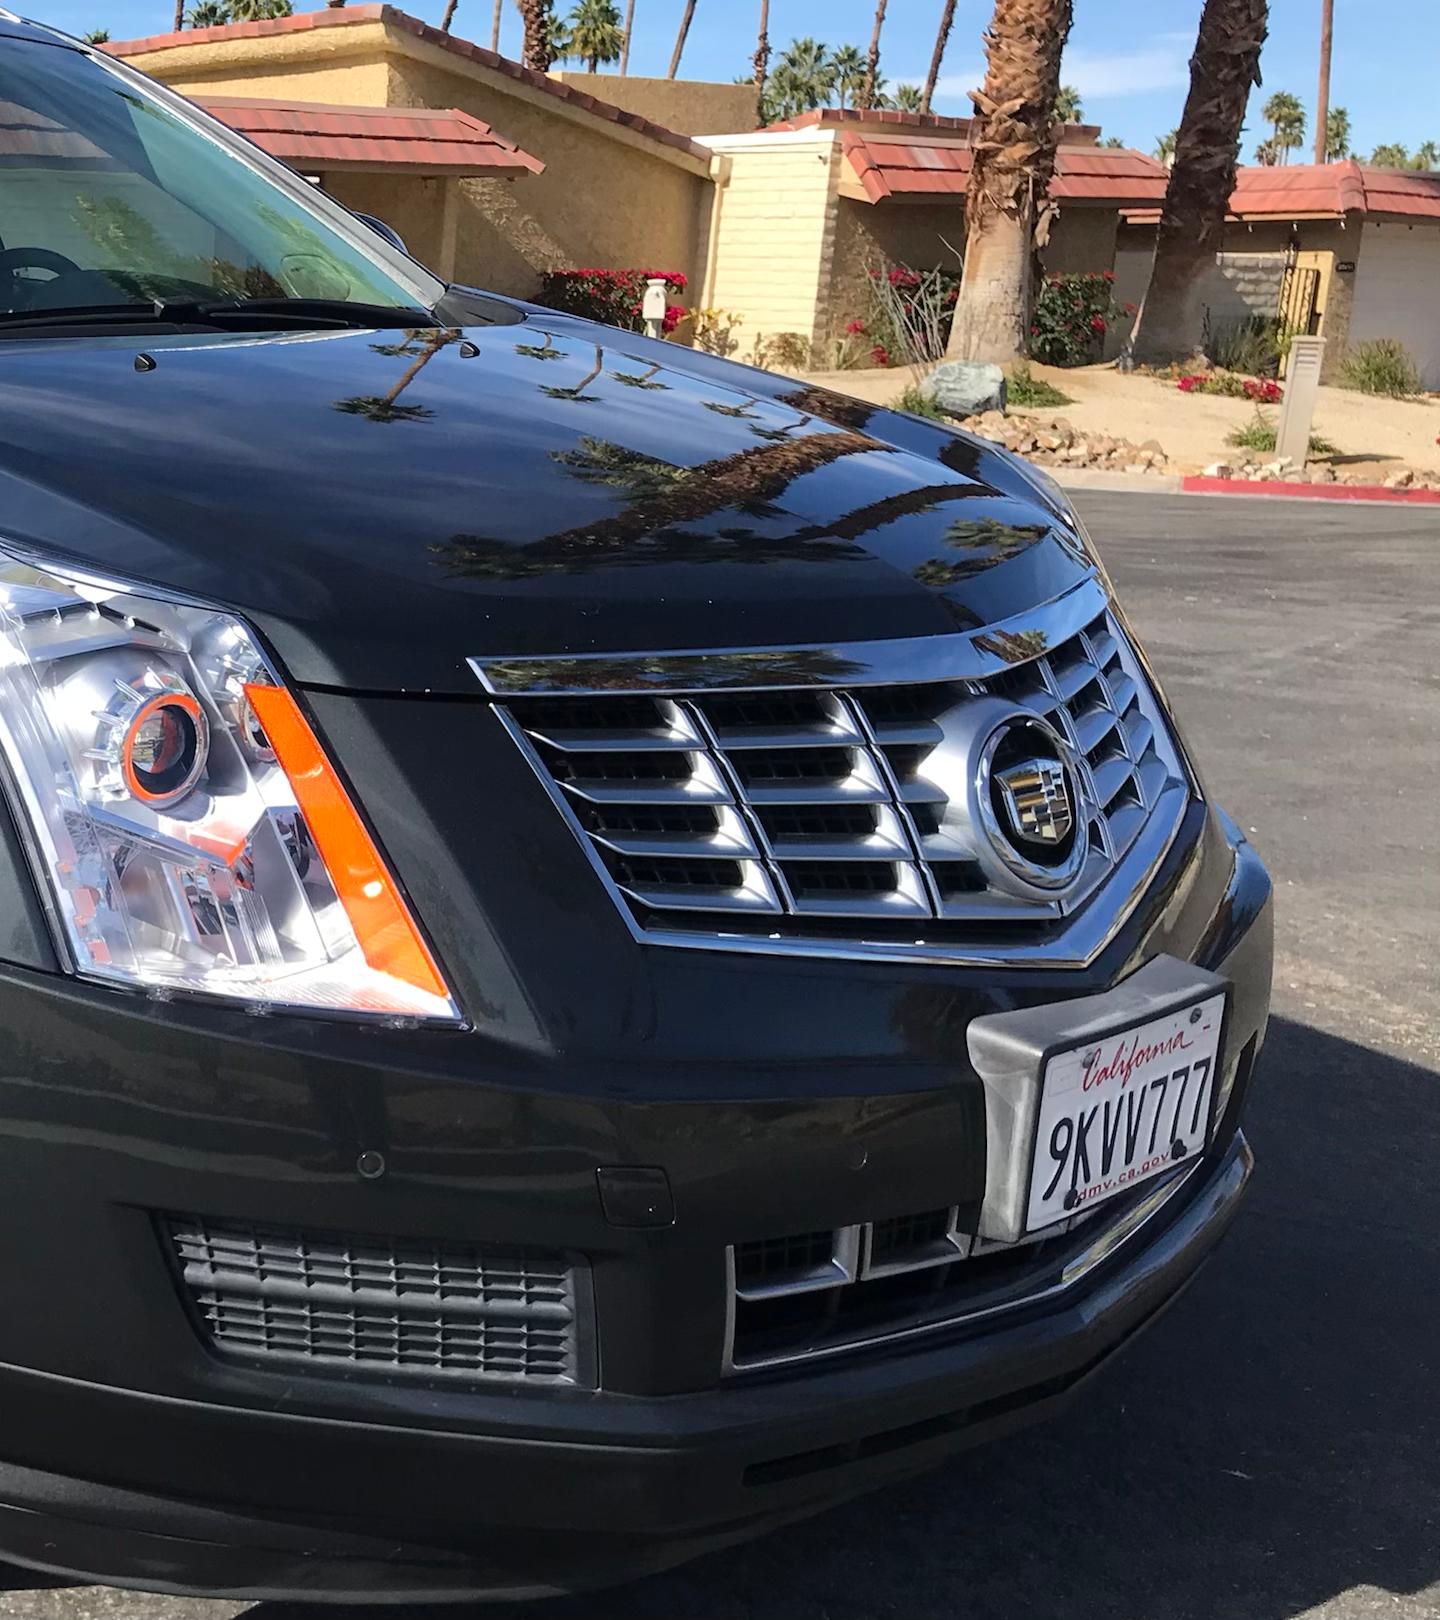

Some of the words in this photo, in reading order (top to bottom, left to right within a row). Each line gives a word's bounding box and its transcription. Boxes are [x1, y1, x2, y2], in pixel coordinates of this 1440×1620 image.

[1082, 1025, 1194, 1093] California
[1042, 1056, 1212, 1201] 9KVV777
[1076, 1150, 1171, 1201] dmv.ca.gov
